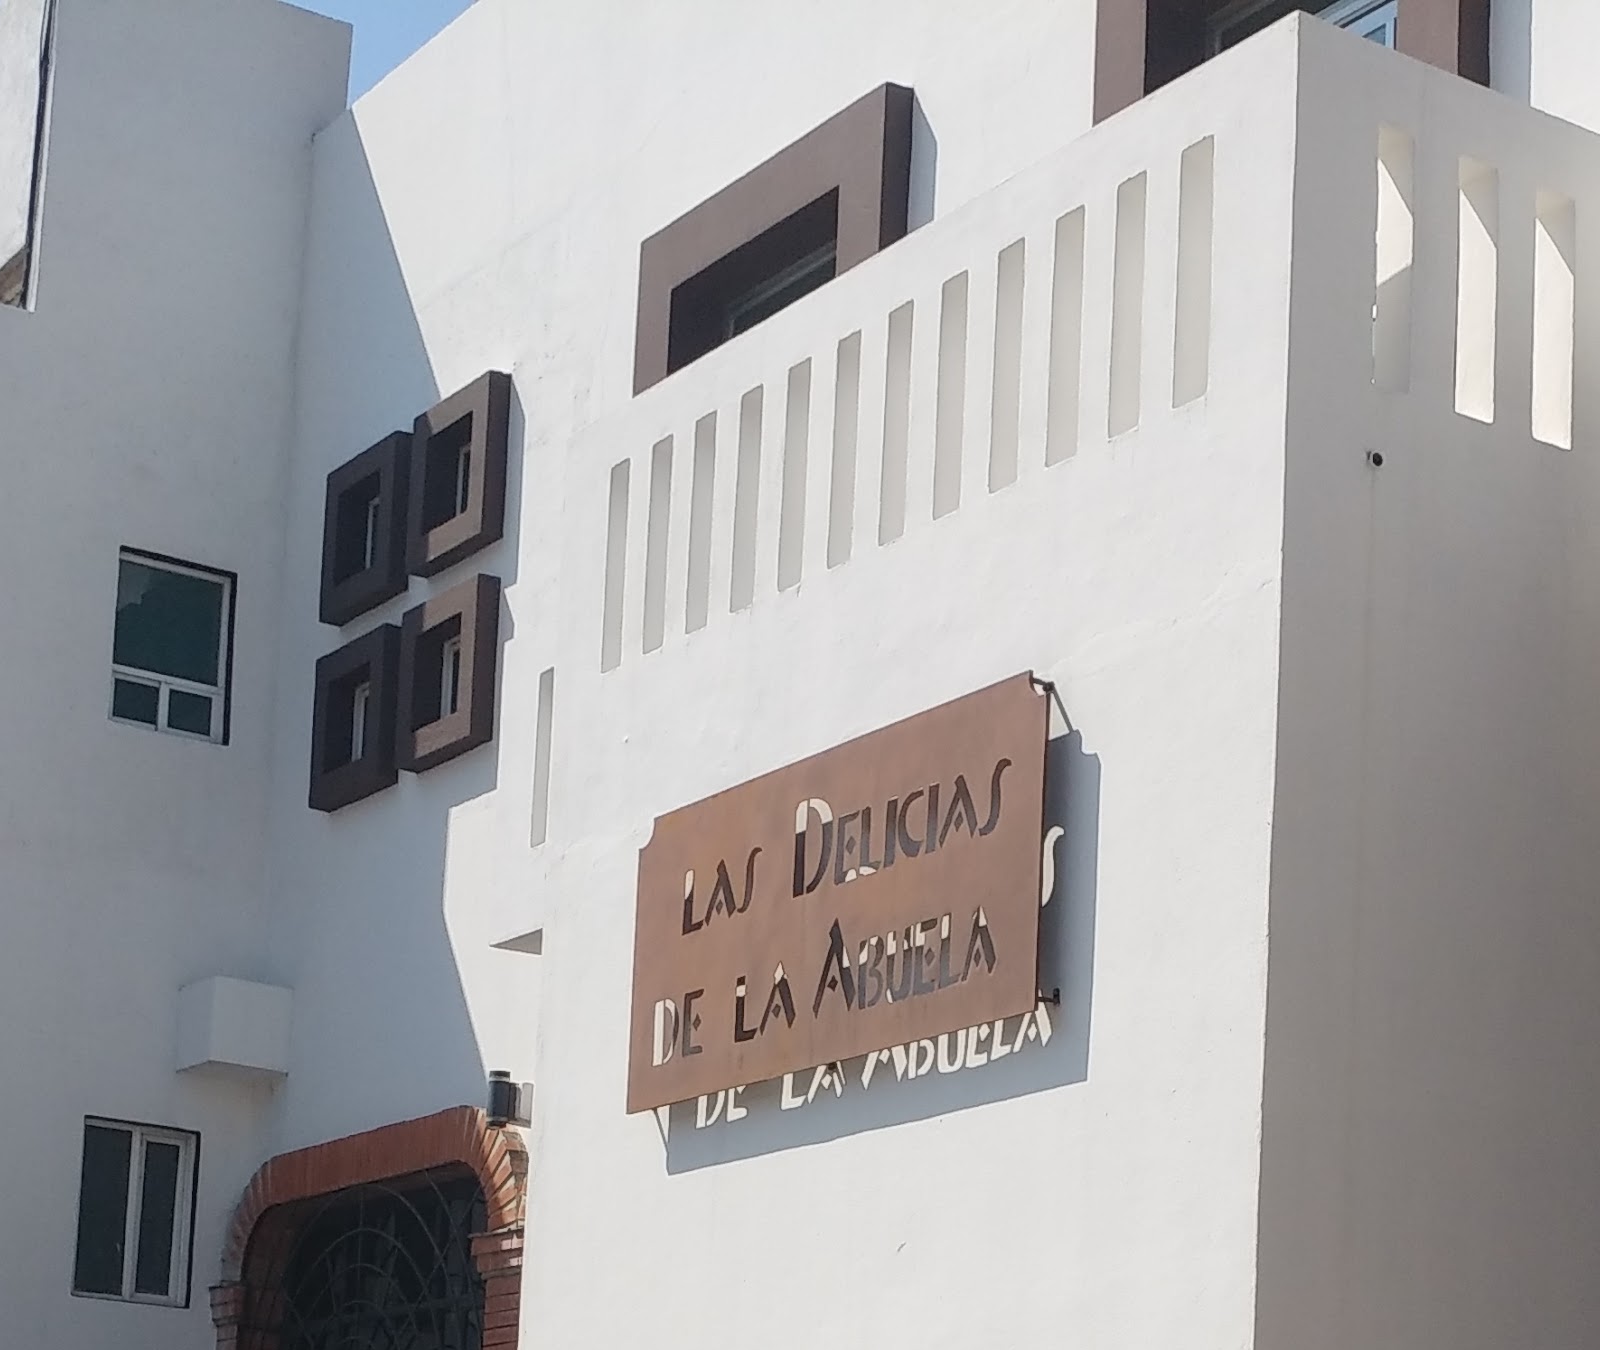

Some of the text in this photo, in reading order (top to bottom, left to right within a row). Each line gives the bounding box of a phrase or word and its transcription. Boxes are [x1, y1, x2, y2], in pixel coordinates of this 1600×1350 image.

[681, 847, 763, 936] LAS
[792, 757, 1013, 899] DELICIAS
[651, 904, 998, 1068] DE LA ABUELA
